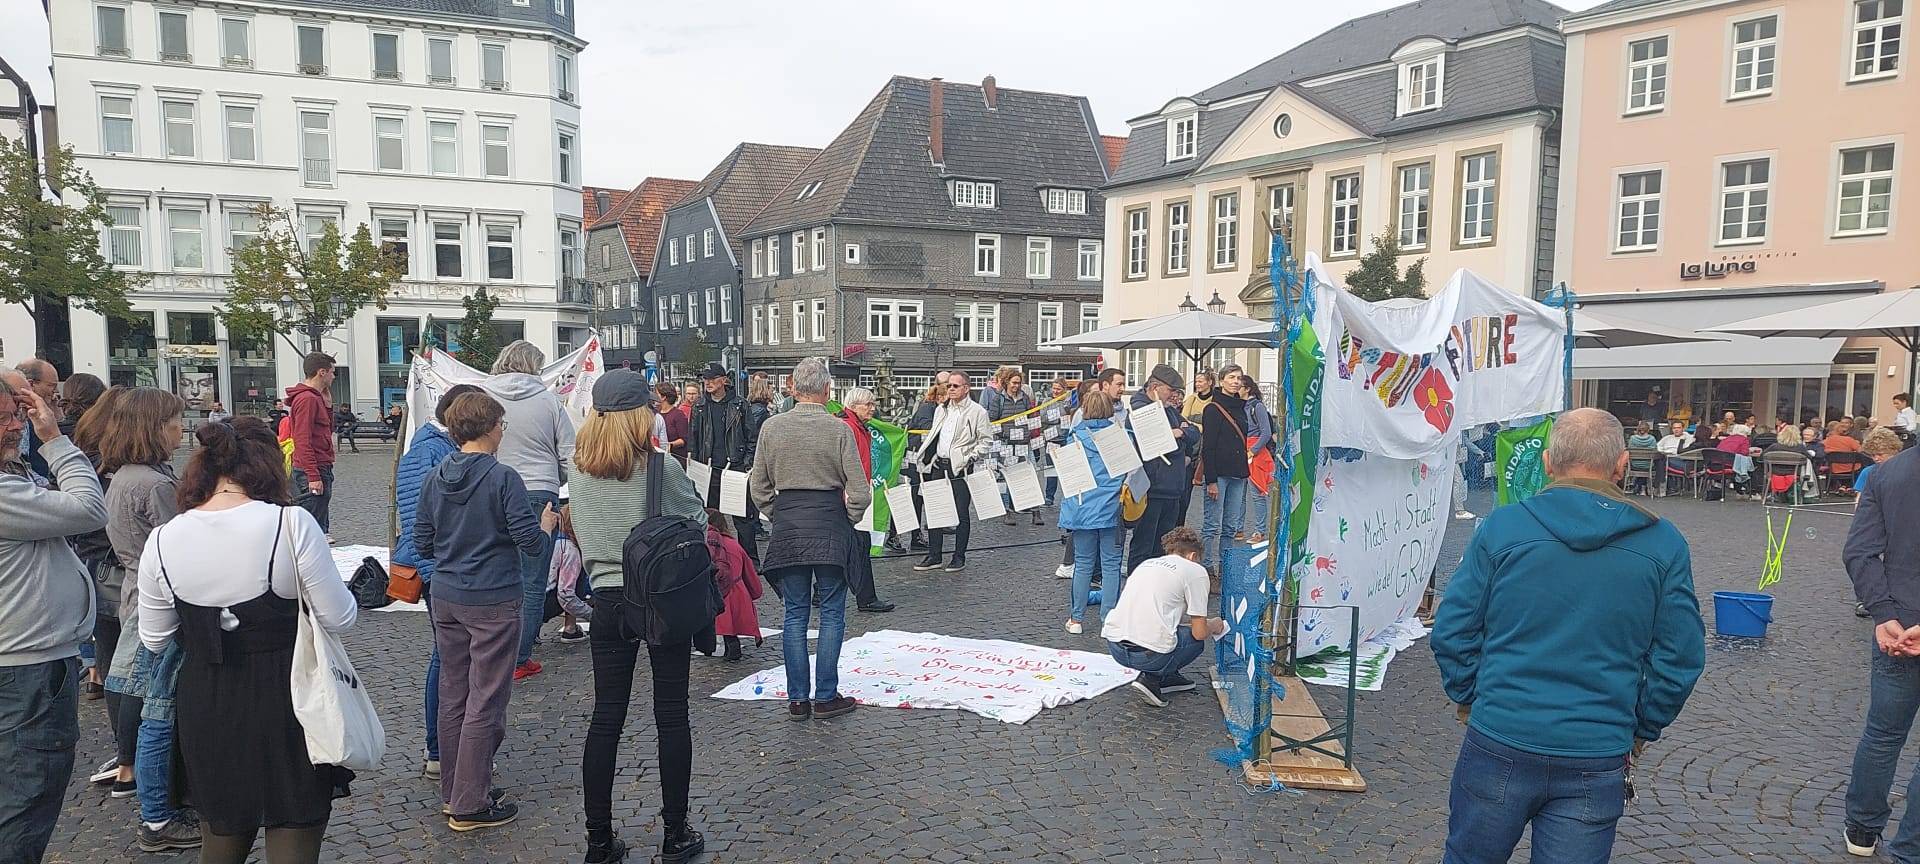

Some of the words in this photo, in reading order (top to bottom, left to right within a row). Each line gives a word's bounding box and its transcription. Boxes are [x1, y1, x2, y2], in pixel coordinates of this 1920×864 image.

[1405, 487, 1437, 531] Stadt
[1367, 558, 1395, 599] wieder
[921, 658, 1015, 676] Bienen
